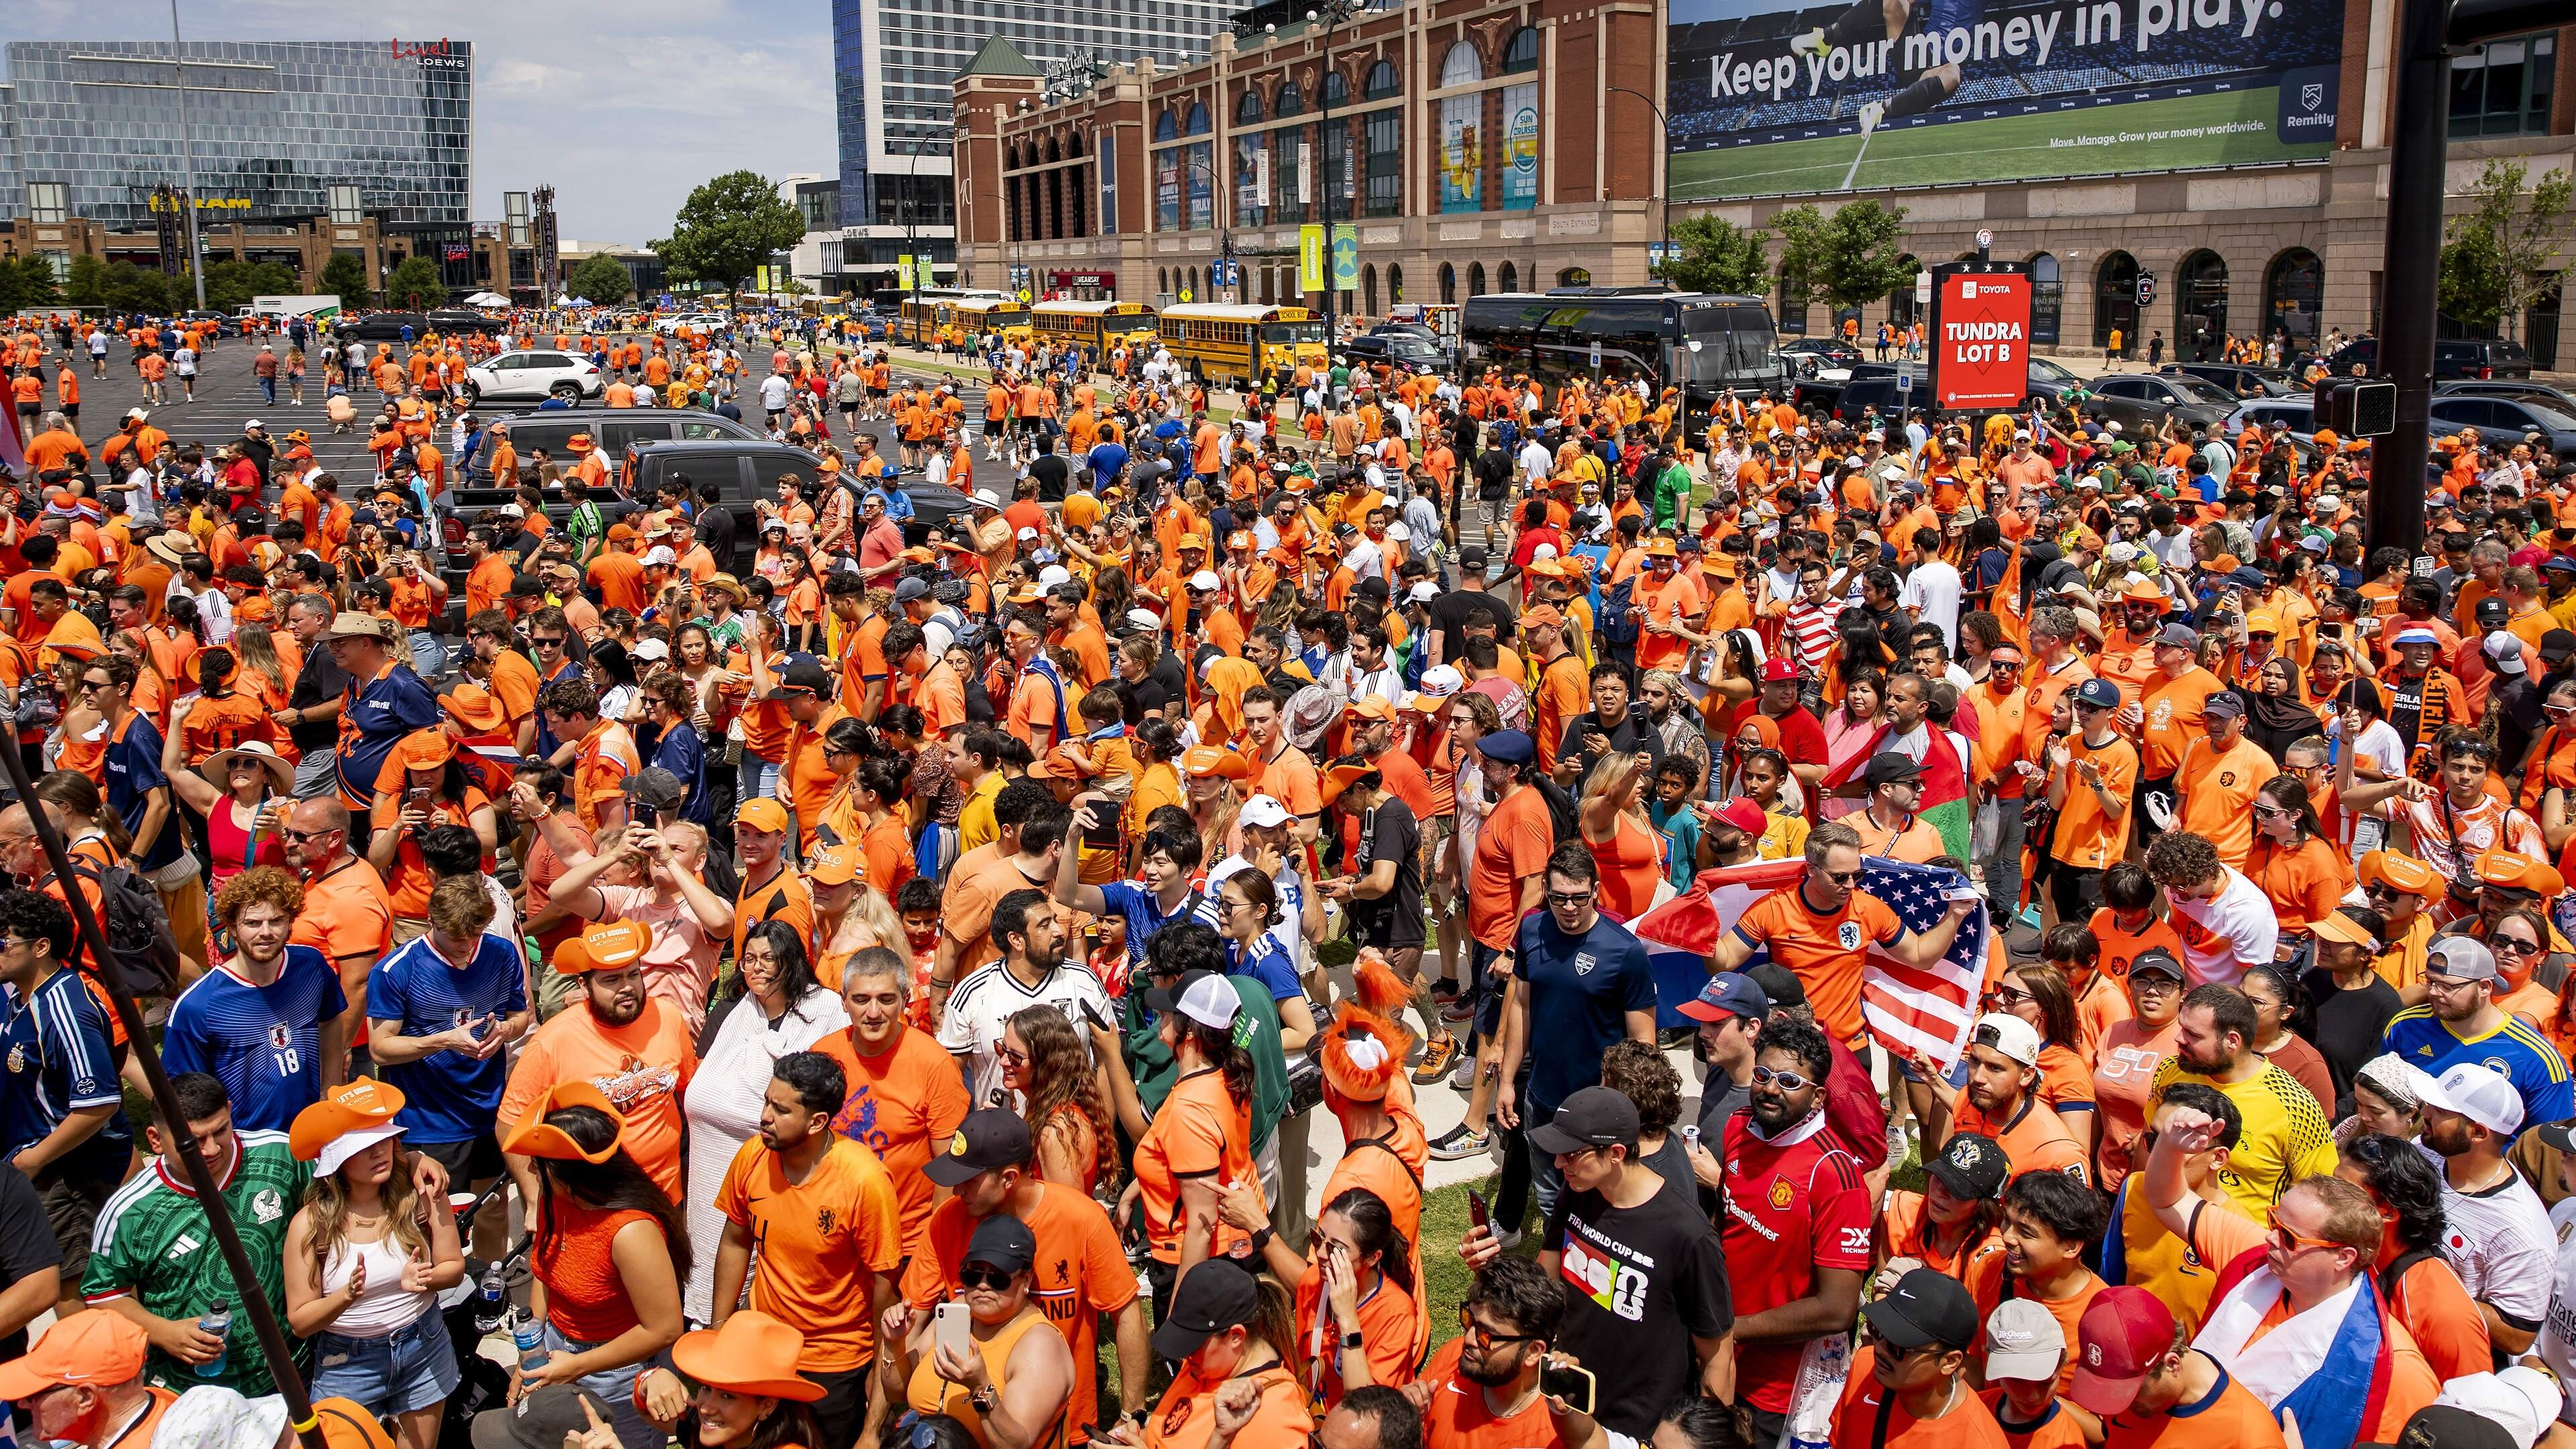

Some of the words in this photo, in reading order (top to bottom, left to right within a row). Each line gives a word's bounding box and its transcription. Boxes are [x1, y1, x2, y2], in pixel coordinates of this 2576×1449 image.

[391, 37, 449, 60] Live!
[1711, 52, 1796, 101] Keep
[1807, 38, 1895, 96] your
[1904, 10, 2061, 70] money
[2076, 0, 2122, 46] in
[2137, 0, 2283, 52] play.
[416, 58, 465, 68] LOEWS
[1519, 115, 1533, 124] SUN
[2287, 113, 2335, 128] Remitly
[2049, 137, 2077, 148] Move.
[2078, 134, 2116, 147] Manage.
[2118, 131, 2145, 142] Grow
[2147, 130, 2169, 142] your
[2170, 127, 2206, 138] money
[2206, 120, 2266, 135] worldwide.
[1552, 220, 1569, 229] SOUTH
[1570, 219, 1597, 228] ENTRANCE
[843, 227, 869, 237] LOEWS
[1979, 285, 2010, 294] TOYOTA
[1945, 322, 2023, 341] TUNDRA
[1957, 344, 1994, 363] LOT
[1998, 343, 2010, 362] B
[2002, 425, 2010, 441] 9
[2387, 856, 2403, 867] LET'S
[2491, 854, 2505, 863] LET'S
[588, 932, 607, 943] LET'S
[1248, 1016, 1260, 1036] USA
[274, 1049, 300, 1077] 18
[337, 1091, 354, 1103] LET'S
[1729, 1198, 1780, 1242] TeamViewer
[1568, 1212, 1582, 1230] FIFA
[1581, 1223, 1611, 1248] WORLD
[1611, 1240, 1632, 1258] CUP
[1563, 1242, 1612, 1296] 26
[1621, 1306, 1634, 1316] FIFA
